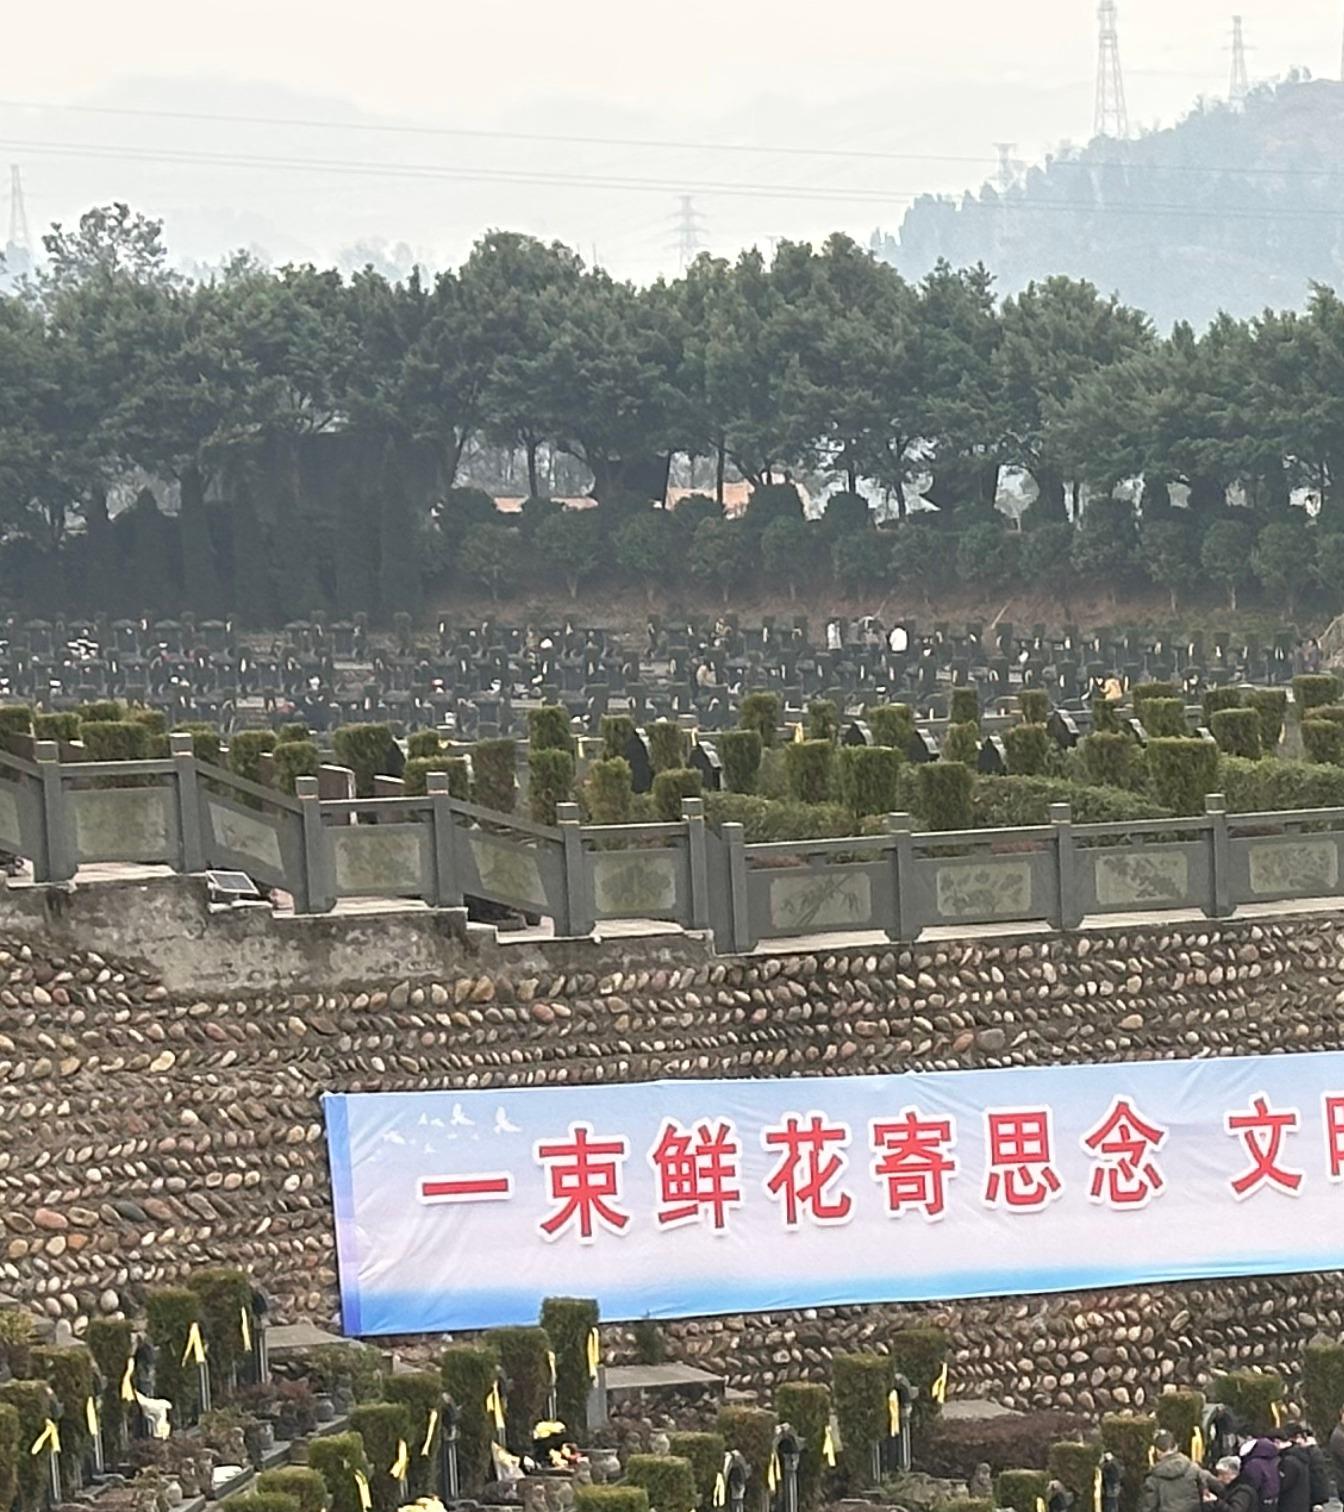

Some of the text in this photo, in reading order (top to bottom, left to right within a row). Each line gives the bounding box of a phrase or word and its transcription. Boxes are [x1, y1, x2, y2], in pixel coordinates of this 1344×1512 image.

[421, 1100, 1164, 1238] 一束鲜花寄思念
